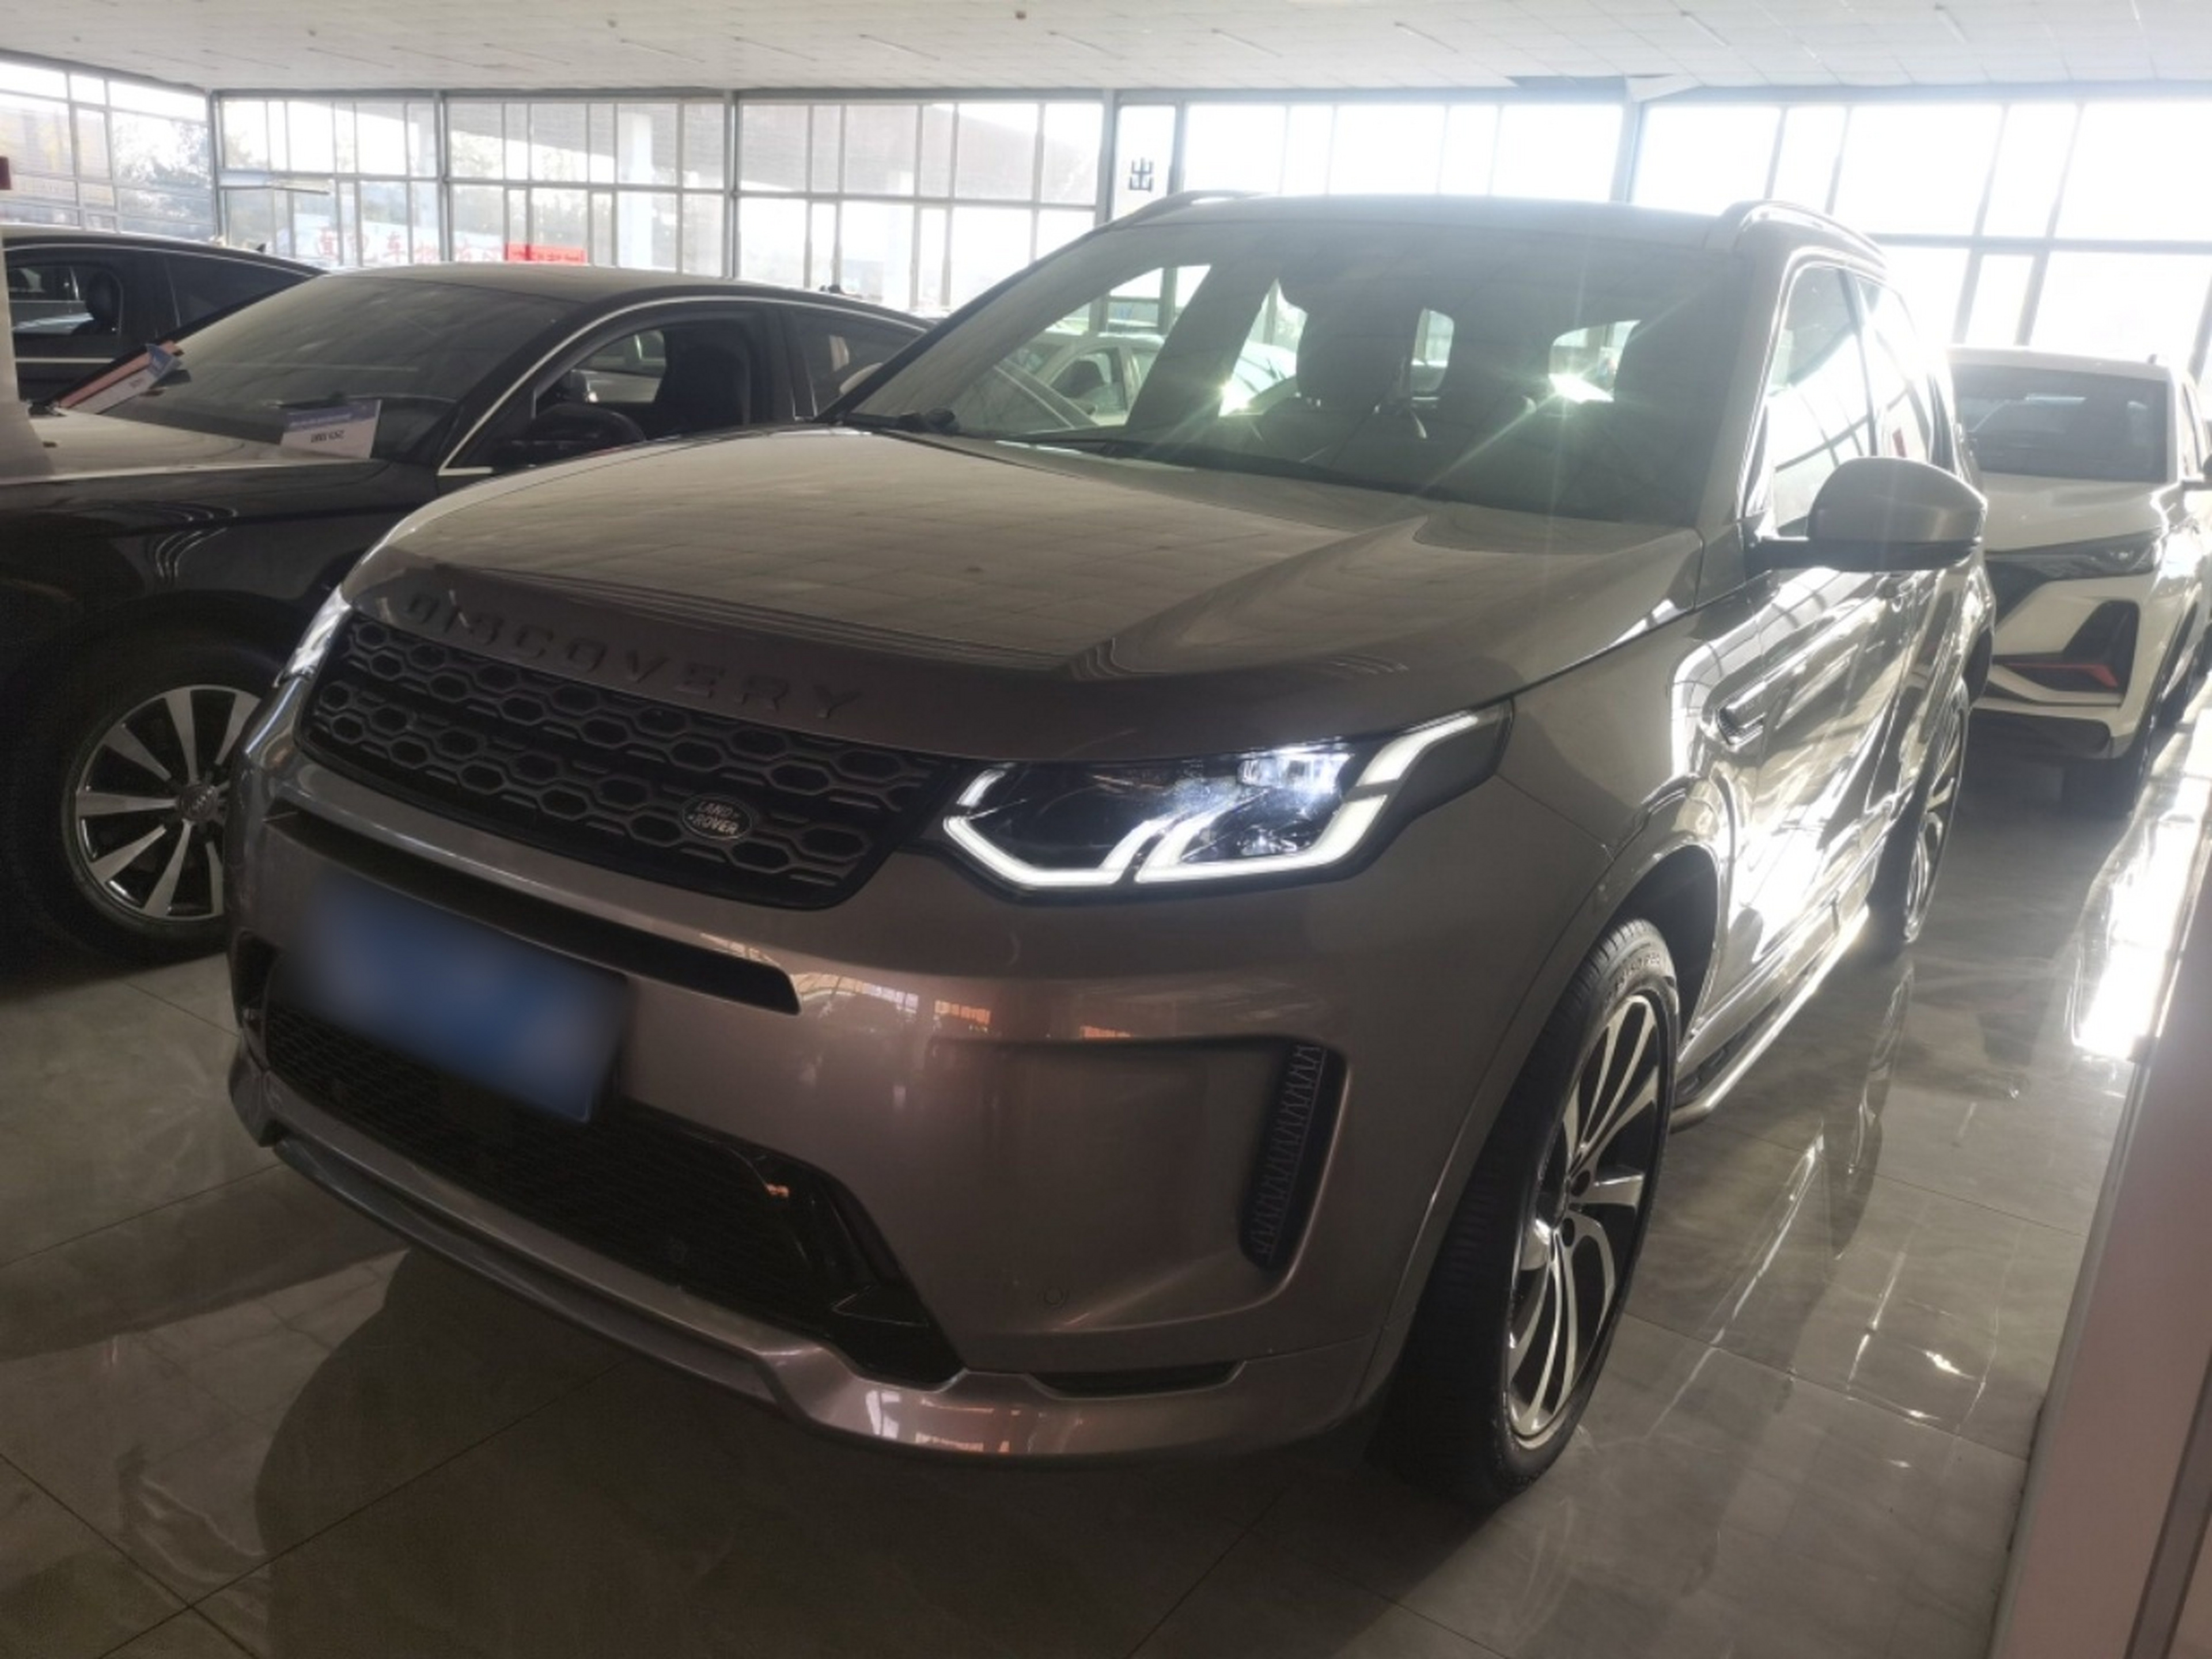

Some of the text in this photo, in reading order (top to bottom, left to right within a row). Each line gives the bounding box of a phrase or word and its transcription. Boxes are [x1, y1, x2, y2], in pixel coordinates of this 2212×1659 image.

[1128, 157, 1153, 192] 出
[404, 591, 862, 719] DISCOVERY
[695, 801, 733, 817] LAND
[692, 813, 739, 834] ROVER
